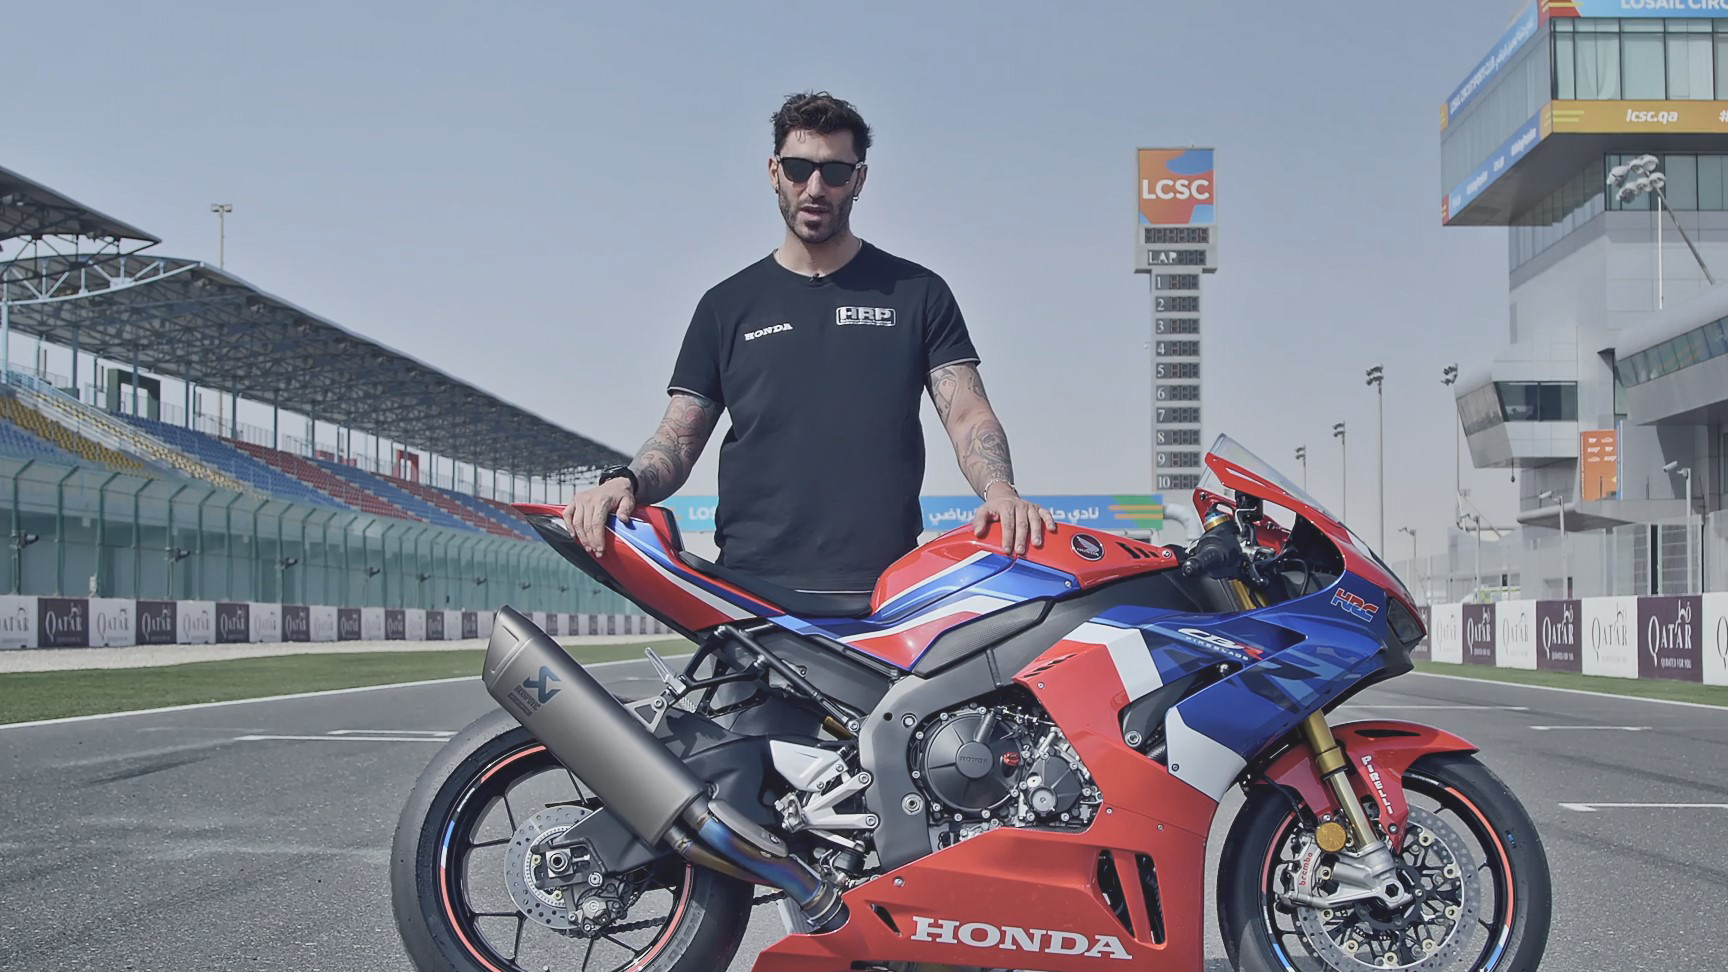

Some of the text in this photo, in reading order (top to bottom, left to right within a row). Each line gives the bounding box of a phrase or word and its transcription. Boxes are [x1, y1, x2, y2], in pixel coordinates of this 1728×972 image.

[1621, 0, 1685, 9] LOSAIL
[1625, 108, 1679, 125] lcsc.qa
[1142, 179, 1210, 200] LCSC
[1149, 251, 1178, 264] LAP
[1157, 276, 1161, 289] 1
[1157, 298, 1165, 311] 2
[840, 307, 892, 321] HRP
[744, 323, 793, 341] HONDA
[1157, 320, 1164, 333] 3
[1157, 343, 1165, 355] 4
[1157, 365, 1164, 377] 5
[1157, 387, 1165, 400] 6
[1157, 409, 1165, 422] 7
[1157, 431, 1165, 443] 8
[1157, 453, 1166, 466] 9
[1158, 476, 1171, 488] 10
[1330, 587, 1379, 622] HRC
[1467, 617, 1491, 656] QATAR
[1542, 615, 1574, 660] QATAR
[1592, 617, 1628, 662] QATAR
[1648, 615, 1692, 667] QATAR
[1361, 755, 1394, 815] PIRELLI
[1299, 852, 1313, 886] brembo
[910, 915, 1133, 960] HONDA
